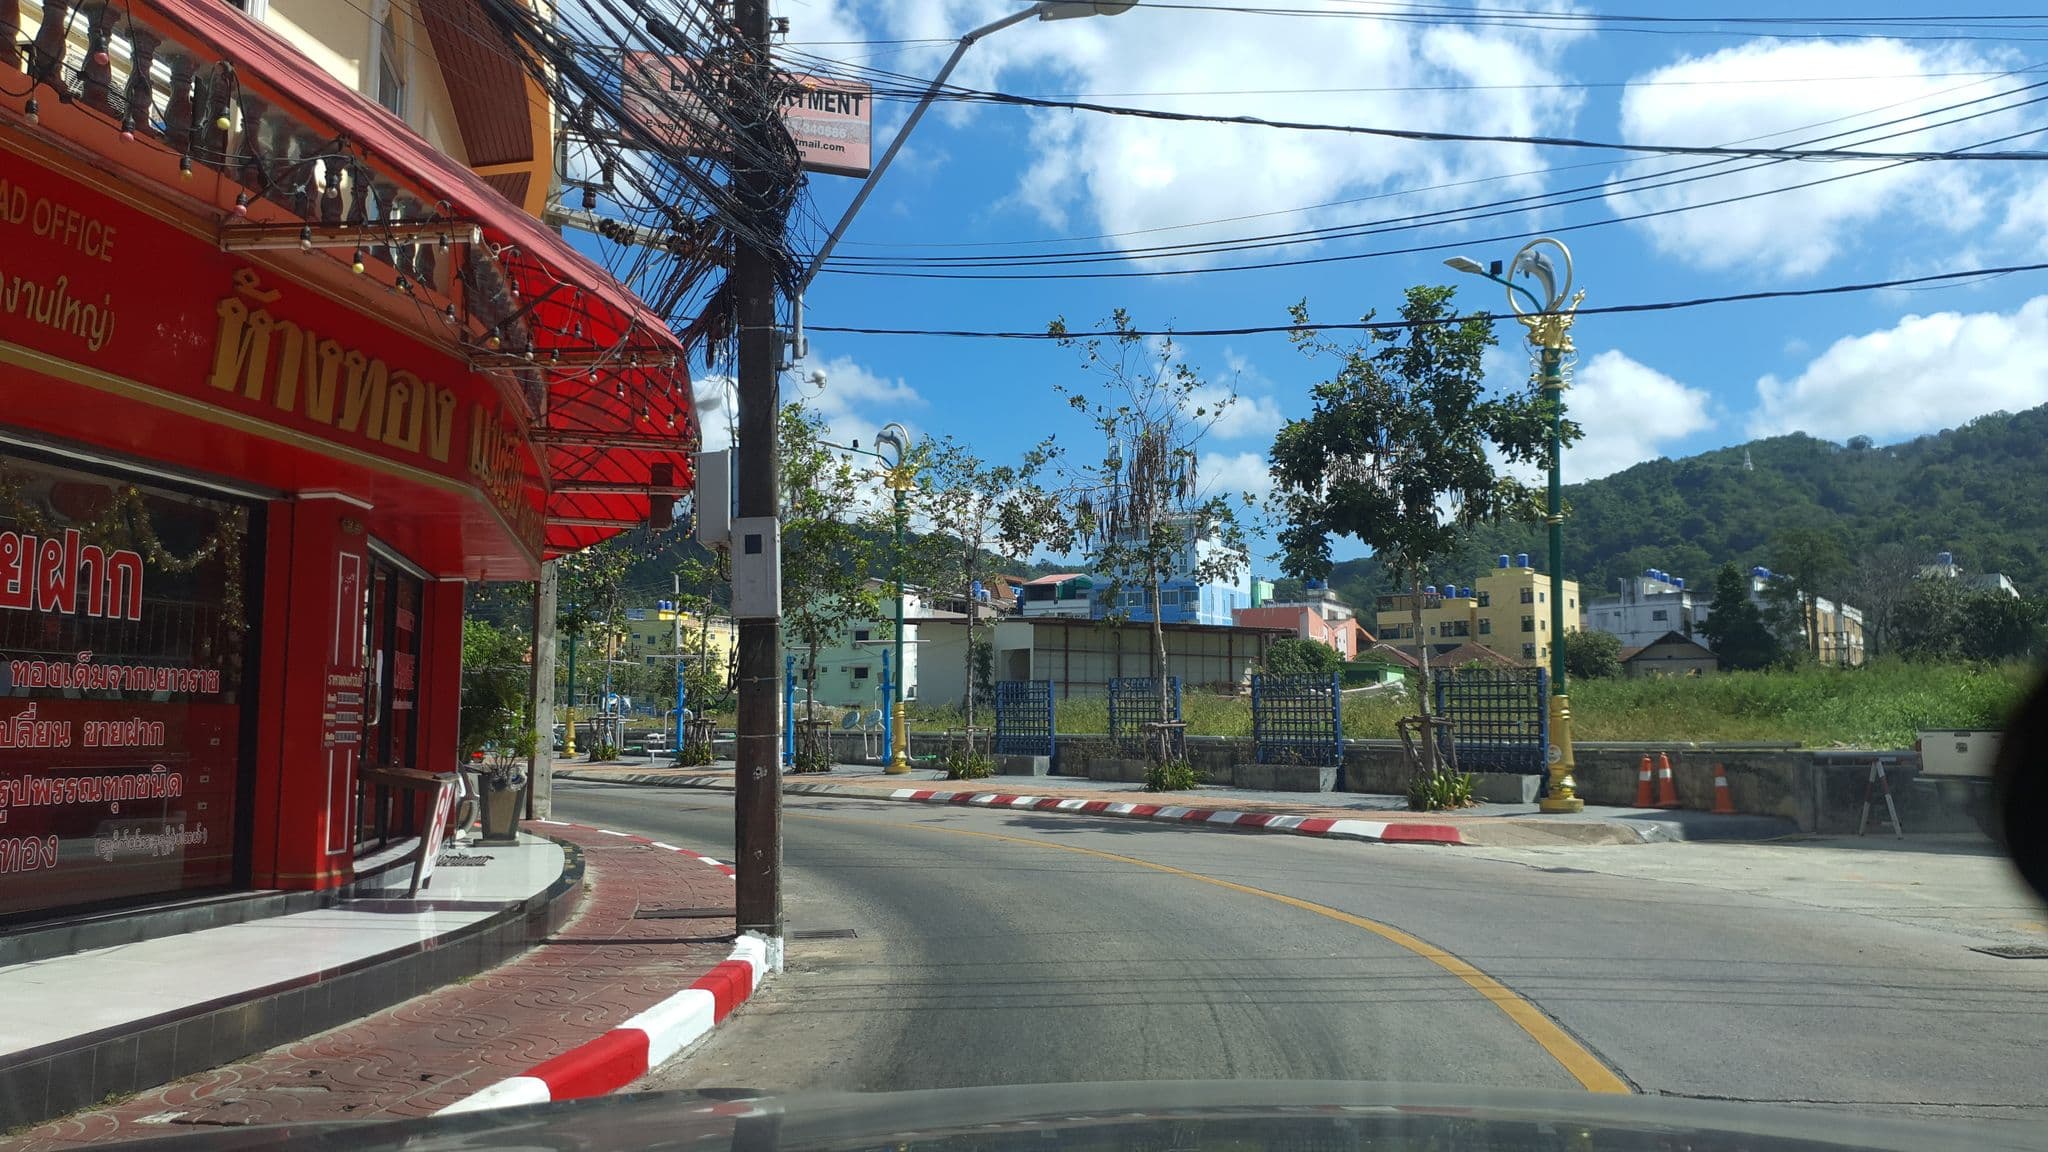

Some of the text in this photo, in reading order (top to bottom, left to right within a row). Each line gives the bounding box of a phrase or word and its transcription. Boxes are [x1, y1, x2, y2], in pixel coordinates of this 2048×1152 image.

[795, 138, 846, 153] tmail.com
[32, 197, 117, 263] OFFICE
[10, 650, 221, 694] ทองเต็มจากเยาวราช
[83, 717, 165, 748] ขายฝาก
